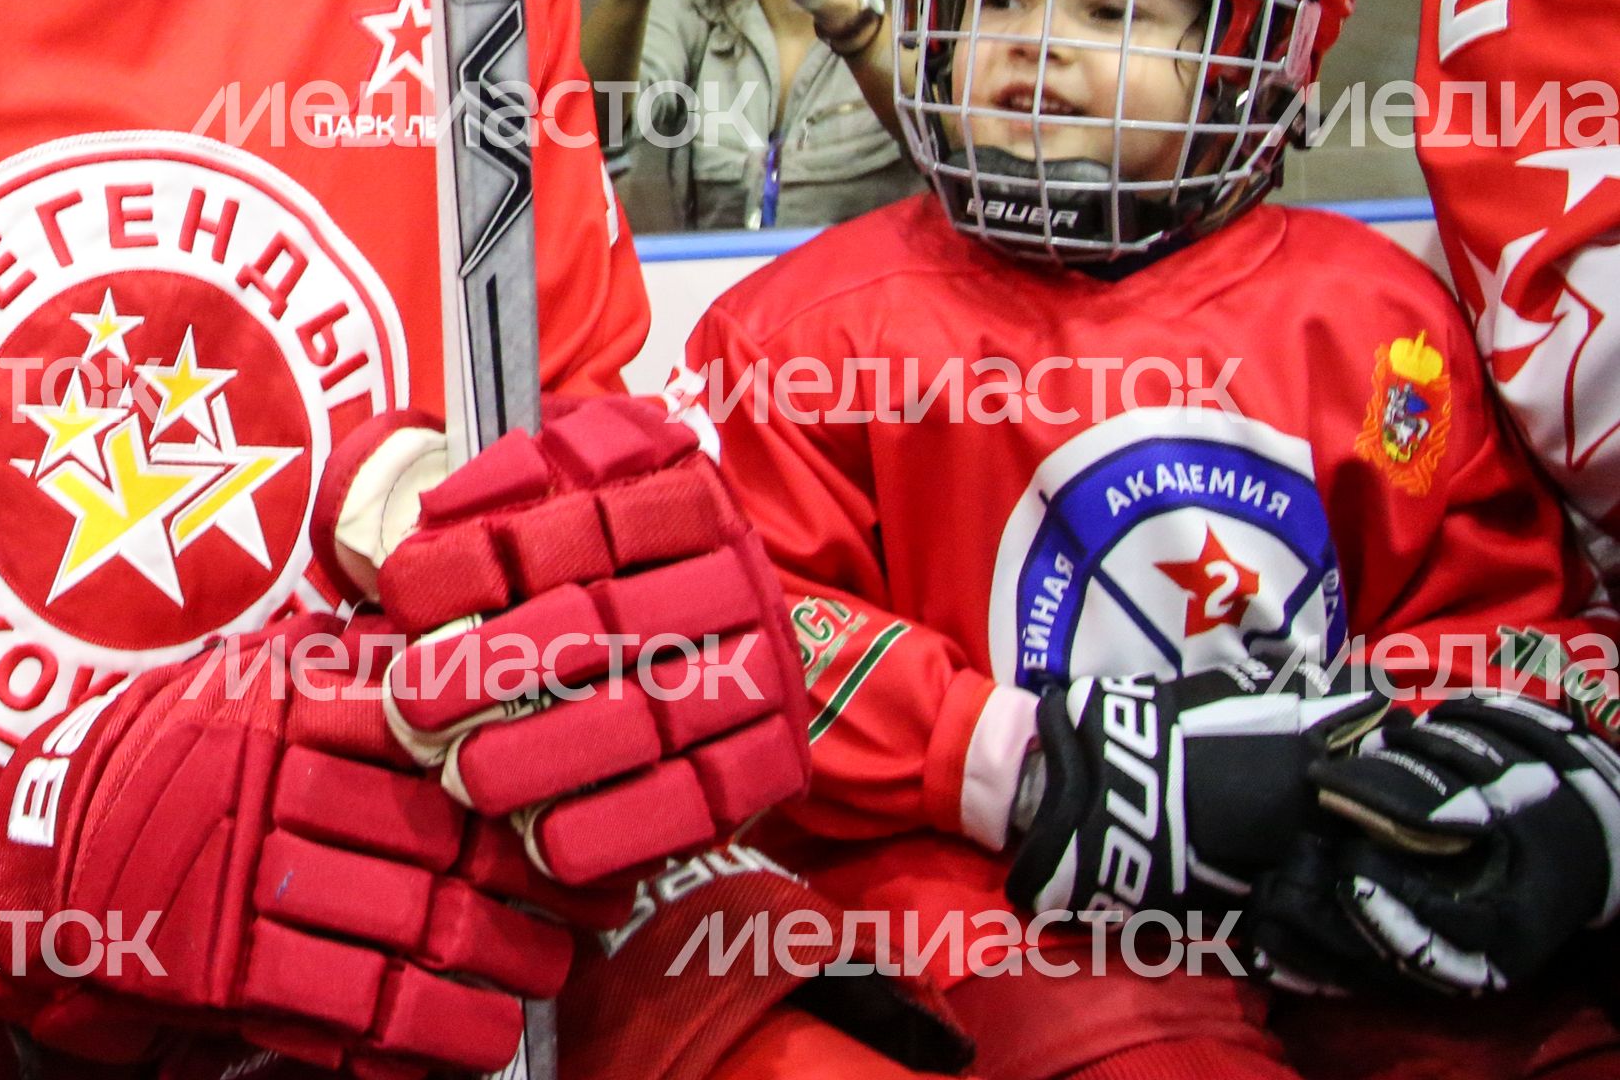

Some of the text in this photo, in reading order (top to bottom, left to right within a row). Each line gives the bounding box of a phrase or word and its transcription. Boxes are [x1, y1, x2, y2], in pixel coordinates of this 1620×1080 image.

[313, 113, 396, 139] ПАРК
[1104, 461, 1292, 521] АКАДЕМИЯ
[1203, 560, 1241, 619] 2
